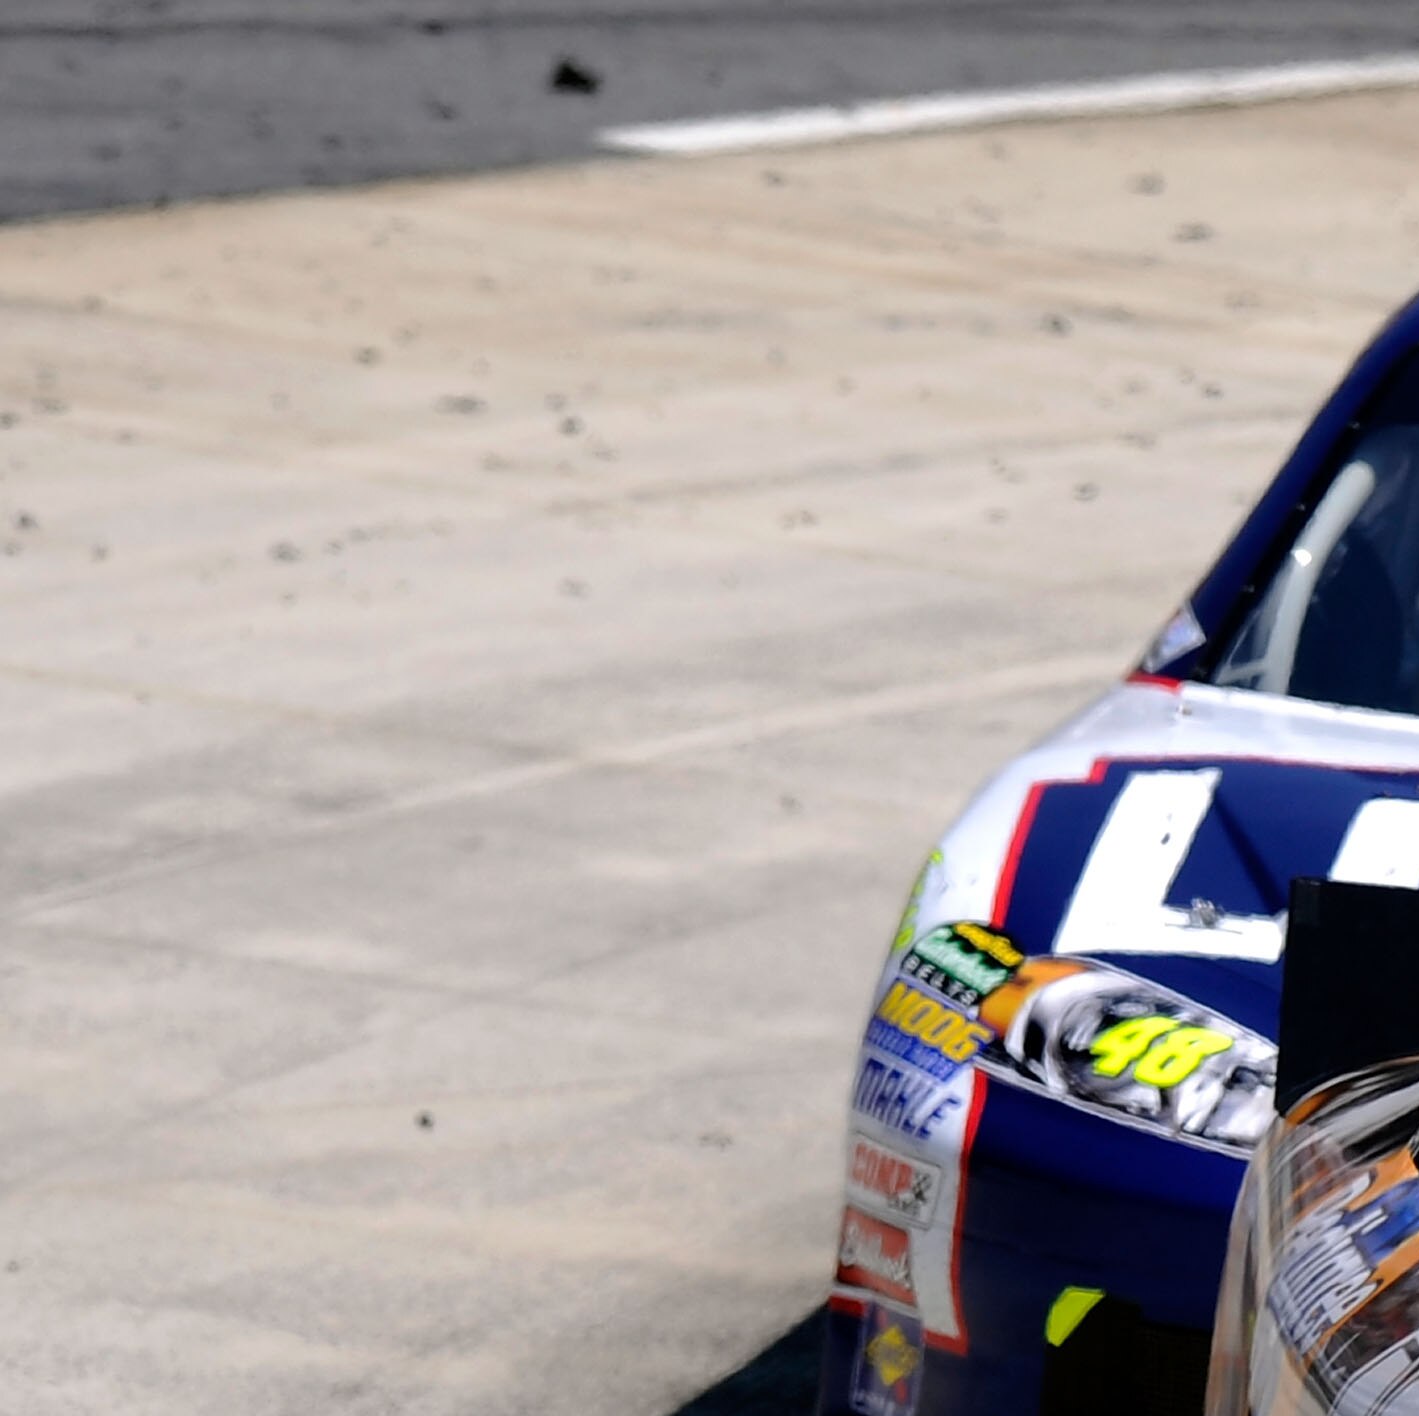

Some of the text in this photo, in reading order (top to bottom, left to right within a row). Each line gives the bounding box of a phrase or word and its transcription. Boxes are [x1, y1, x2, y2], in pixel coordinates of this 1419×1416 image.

[877, 982, 995, 1063] MOOG
[1089, 1016, 1234, 1088] 48
[853, 1058, 962, 1140] MAHLE
